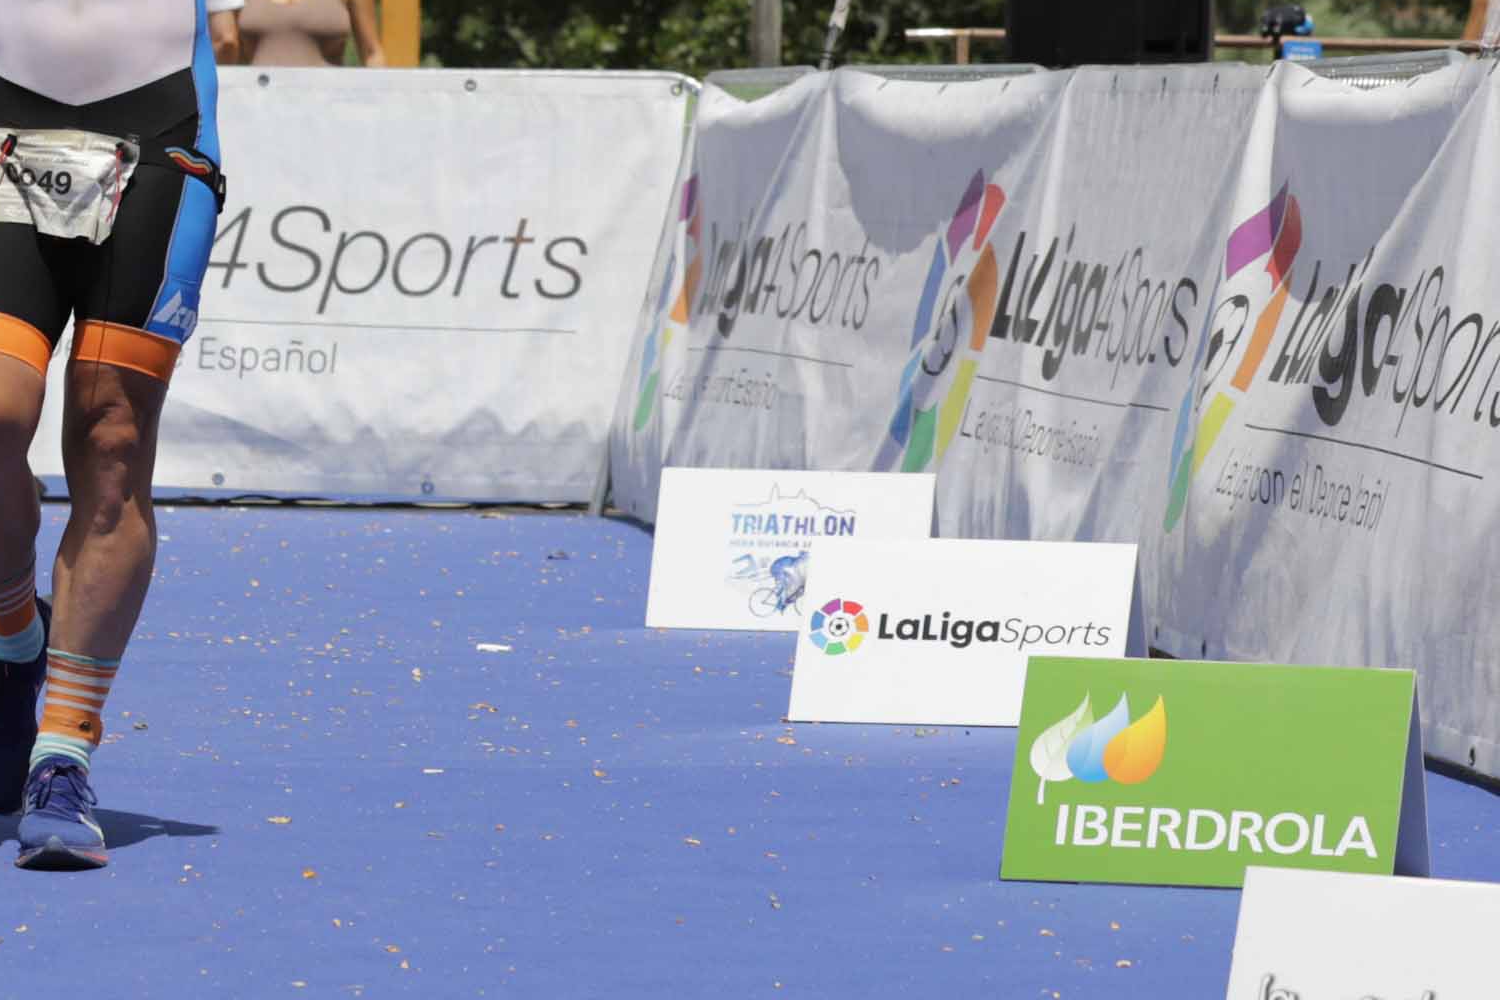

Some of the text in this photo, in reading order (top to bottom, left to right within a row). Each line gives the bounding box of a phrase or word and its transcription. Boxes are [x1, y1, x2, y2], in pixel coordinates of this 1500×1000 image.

[197, 336, 338, 379] Español
[731, 512, 856, 537] TRIATHLON
[878, 612, 1111, 651] LaLigaSports
[1055, 803, 1379, 858] IBERDROLA
